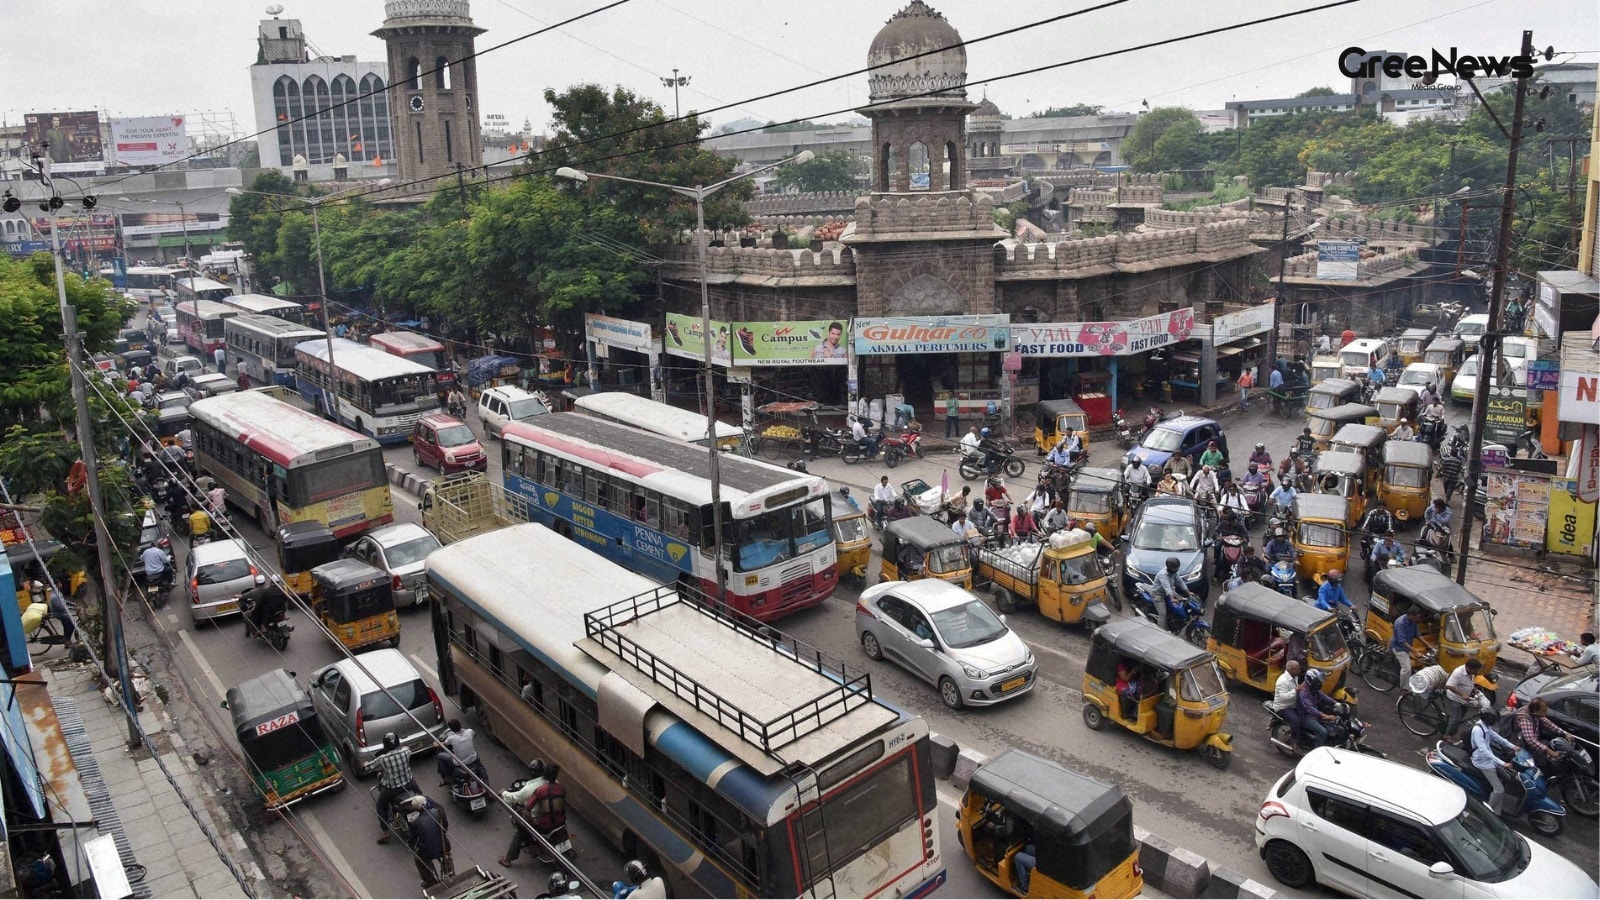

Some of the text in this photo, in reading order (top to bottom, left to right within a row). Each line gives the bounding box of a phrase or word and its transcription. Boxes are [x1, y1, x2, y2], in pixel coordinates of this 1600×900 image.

[856, 320, 871, 329] New
[1140, 318, 1162, 336] YAM
[761, 333, 808, 344] Campus
[863, 324, 958, 343] Gulnar
[1029, 328, 1071, 342] YAM
[869, 343, 988, 353] AKMAL PERFUMERS
[1014, 343, 1084, 354] FAST FOOD
[1130, 333, 1169, 352] FAST FOOD
[1486, 414, 1524, 424] AL-MAKKAH
[572, 501, 595, 517] BIGGER
[573, 516, 595, 529] BETTER
[574, 527, 606, 545] STRONGER
[634, 526, 664, 548] PENNA
[636, 539, 665, 559] CEMENT
[258, 713, 298, 736] RAZA
[888, 733, 905, 749] HYD-2
[926, 854, 941, 868] STOP
